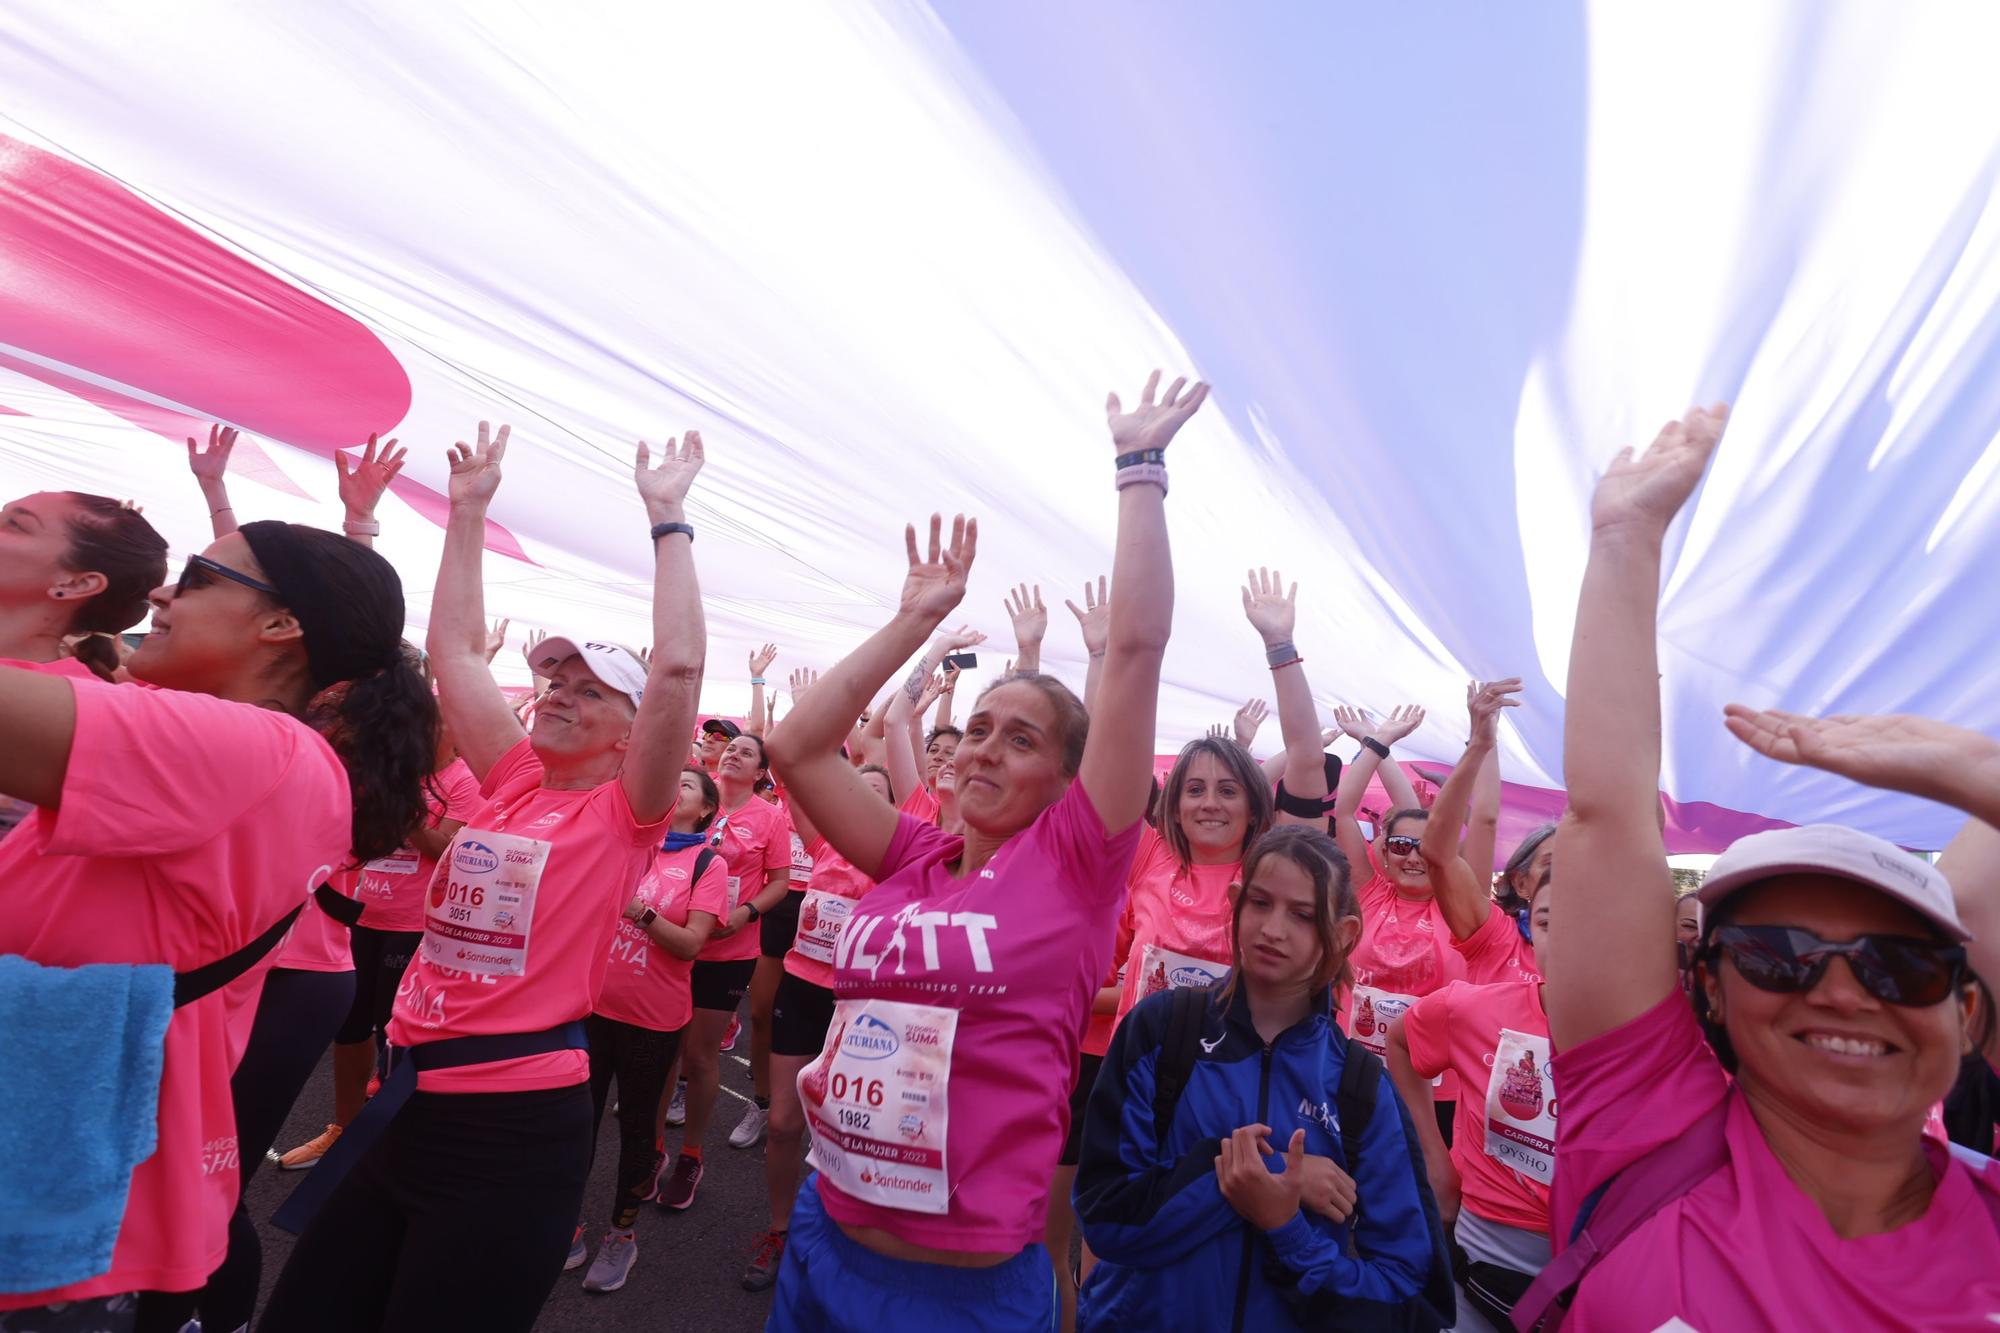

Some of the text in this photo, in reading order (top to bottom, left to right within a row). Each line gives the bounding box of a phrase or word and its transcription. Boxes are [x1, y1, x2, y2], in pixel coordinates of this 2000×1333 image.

[504, 854, 532, 865] SUMA
[448, 882, 485, 906] 016
[449, 906, 471, 922] 3051
[819, 919, 842, 934] 016
[463, 931, 490, 942] MUJER
[491, 936, 513, 946] 2023
[466, 951, 513, 966] Santander
[968, 985, 1007, 995] TEAM
[905, 1032, 938, 1046] SUMA
[831, 1072, 884, 1106] 016
[838, 1109, 871, 1131] 1982
[1503, 1129, 1549, 1151] CARRERA
[851, 1141, 863, 1151] LA
[865, 1144, 899, 1159] MUJER
[902, 1151, 927, 1163] 2023
[1500, 1143, 1547, 1172] OYSHO
[873, 1172, 933, 1194] Santander
